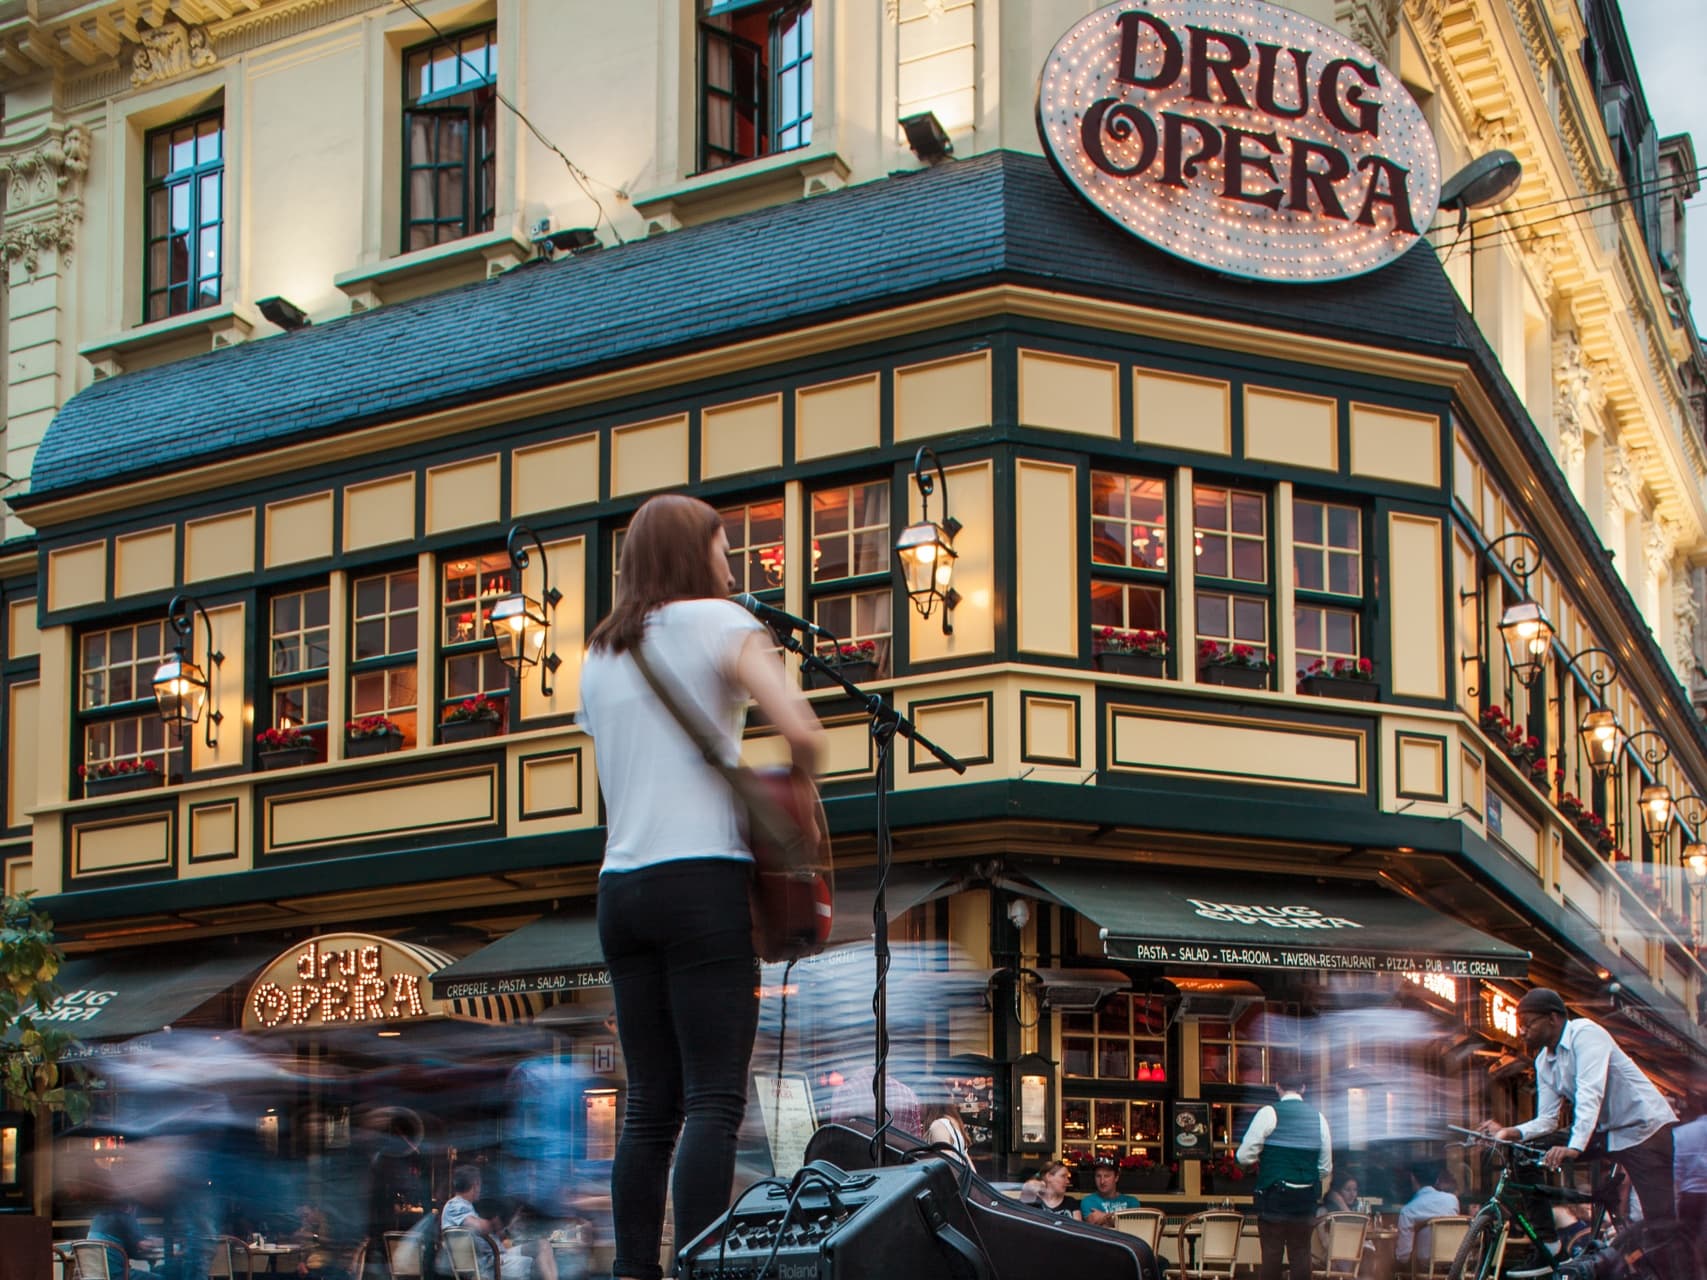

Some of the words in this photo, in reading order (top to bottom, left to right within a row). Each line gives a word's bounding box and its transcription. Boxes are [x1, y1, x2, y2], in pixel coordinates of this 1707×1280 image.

[1115, 10, 1383, 139] DRUG
[1081, 97, 1421, 236] OPERA
[1186, 898, 1323, 918] DRUG
[1137, 944, 1168, 960] PASTA
[1179, 947, 1209, 962] SALAD
[1220, 949, 1271, 964] TEA-ROOM
[1281, 952, 1376, 969] TAVERN-RESTAURANT
[1386, 957, 1416, 970] PIZZA
[1425, 959, 1443, 972] PUB
[1452, 960, 1468, 974] ICE
[1470, 962, 1500, 976] CREAM
[253, 972, 426, 1027] OPERA
[447, 982, 489, 998] CREPERIE
[499, 979, 527, 992] PASTA
[537, 975, 566, 990] SALAD
[577, 970, 611, 985] TEA-RO
[778, 1262, 818, 1280] Roland
